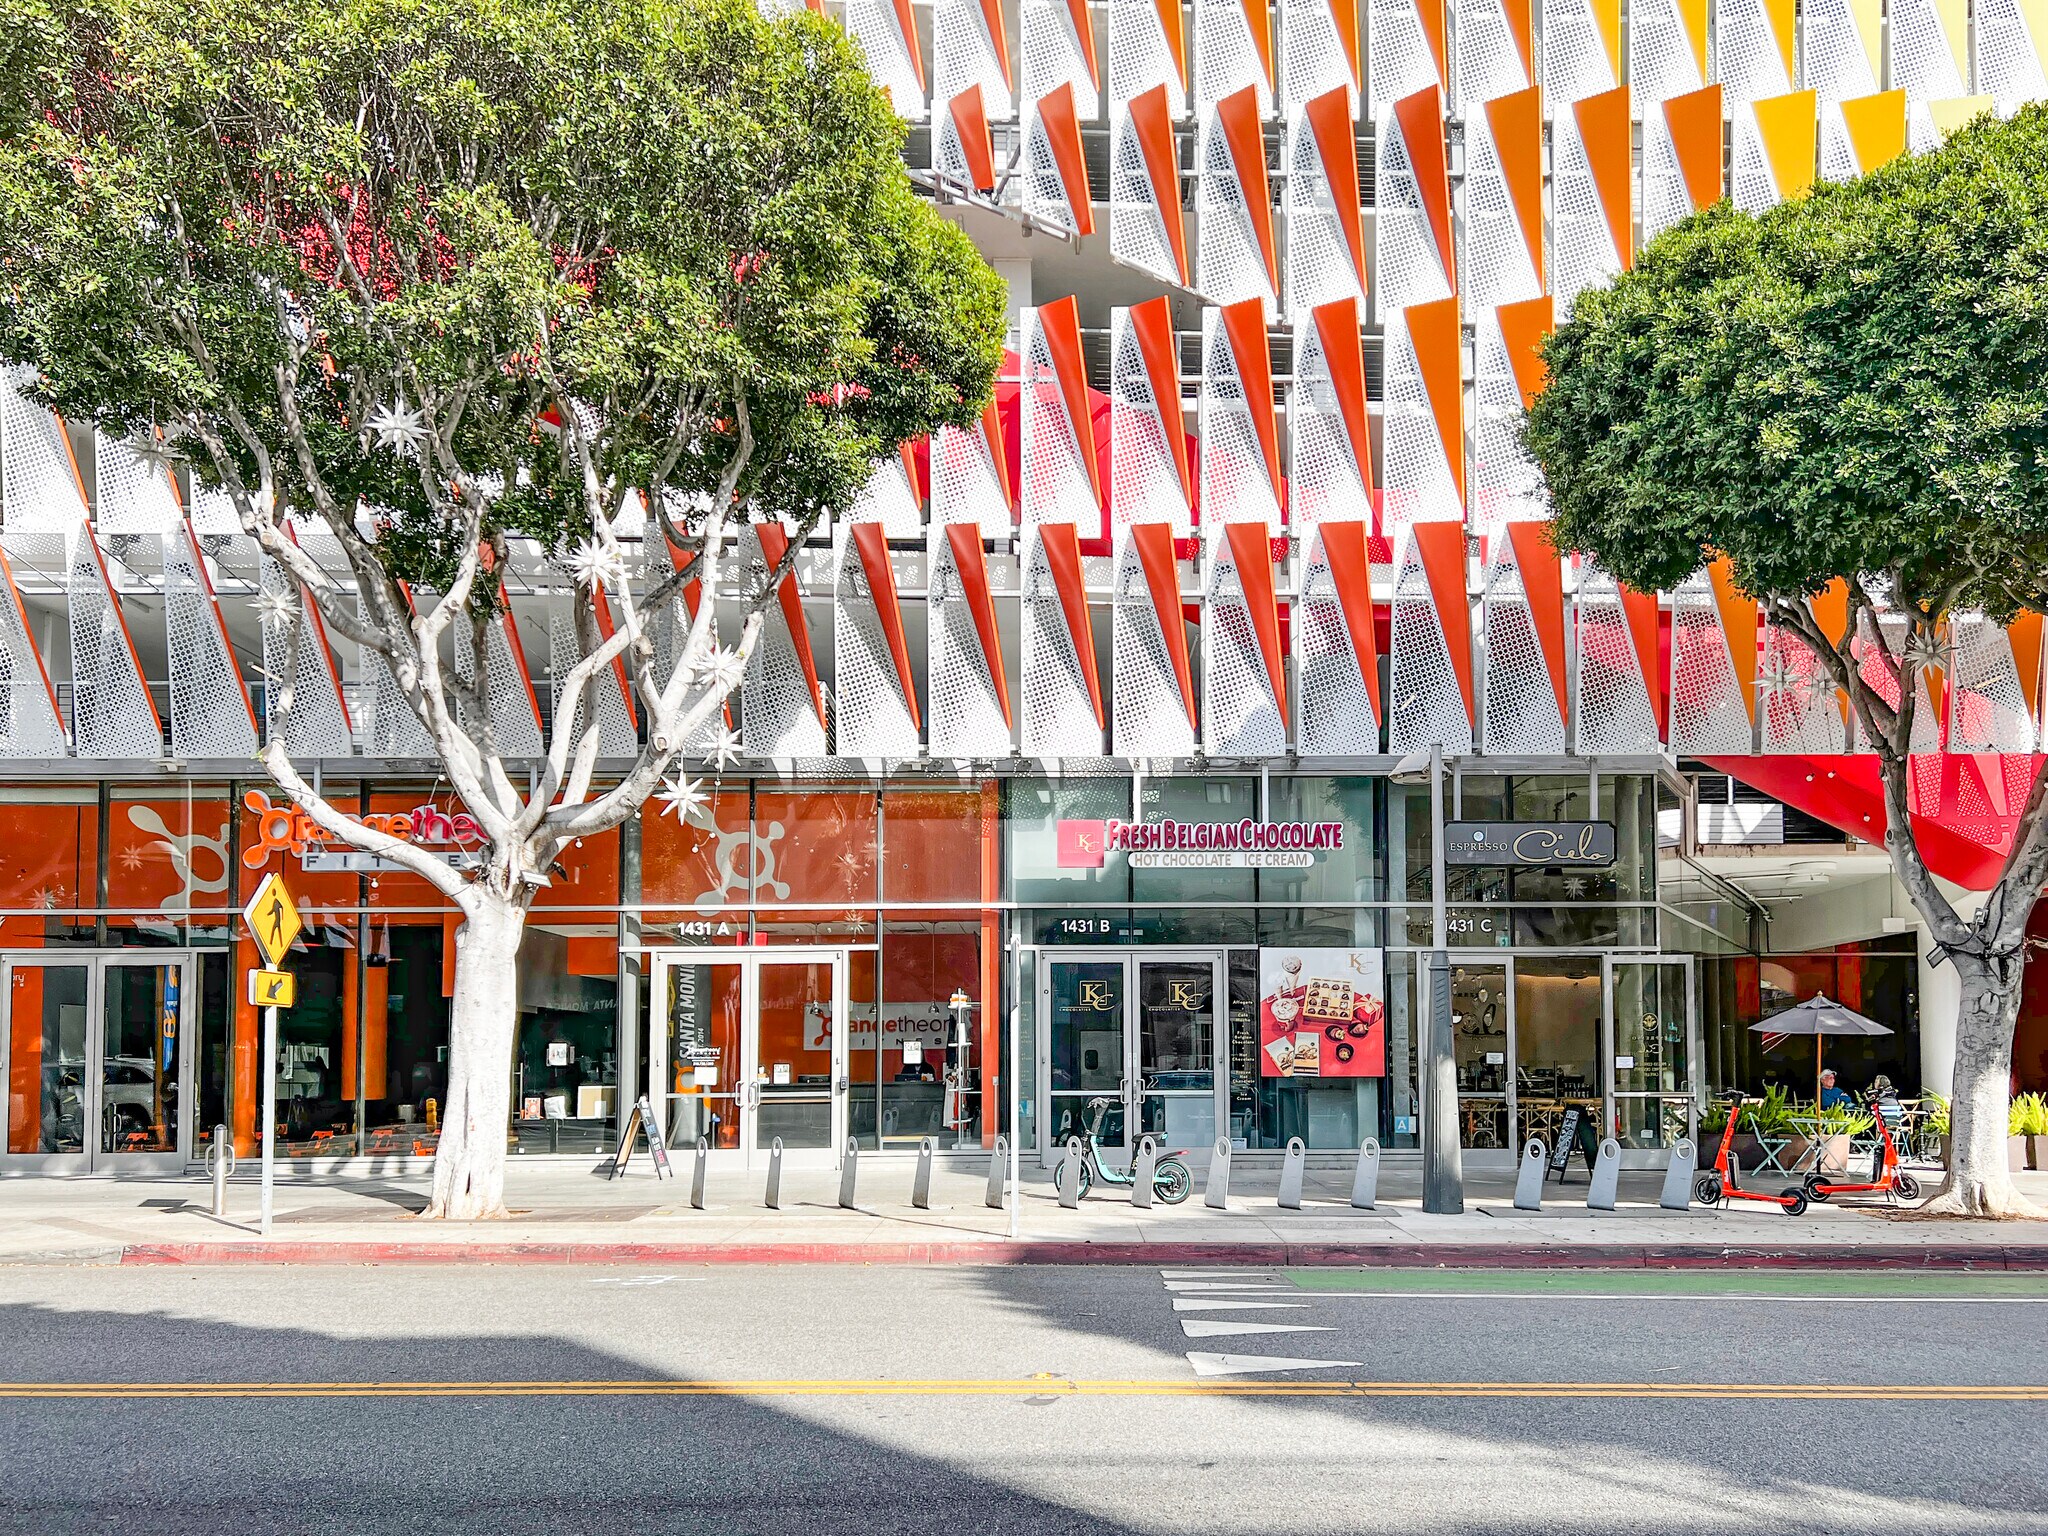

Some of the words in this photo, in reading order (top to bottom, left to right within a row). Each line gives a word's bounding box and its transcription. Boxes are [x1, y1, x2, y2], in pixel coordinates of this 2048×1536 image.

[1108, 820, 1160, 849] FRESH
[1163, 820, 1238, 849] BELGIAN
[1239, 819, 1343, 849] CHOCOLATE
[1449, 842, 1508, 851] ESPRESSO
[1512, 824, 1608, 863] Cielo
[1134, 854, 1160, 866] HOT
[1162, 854, 1231, 866] CHOCOLATE
[1244, 854, 1262, 866] ICE
[1265, 854, 1308, 866] CREAM
[677, 922, 711, 936] 1431
[717, 922, 730, 936] A
[1061, 919, 1093, 933] 1431
[1100, 919, 1110, 933] B
[1480, 919, 1492, 932] C
[679, 964, 695, 1009] MONIC
[1082, 983, 1115, 1011] KC
[1171, 983, 1204, 1011] KC
[679, 1012, 695, 1058] SANTA
[1397, 1120, 1407, 1130] A
